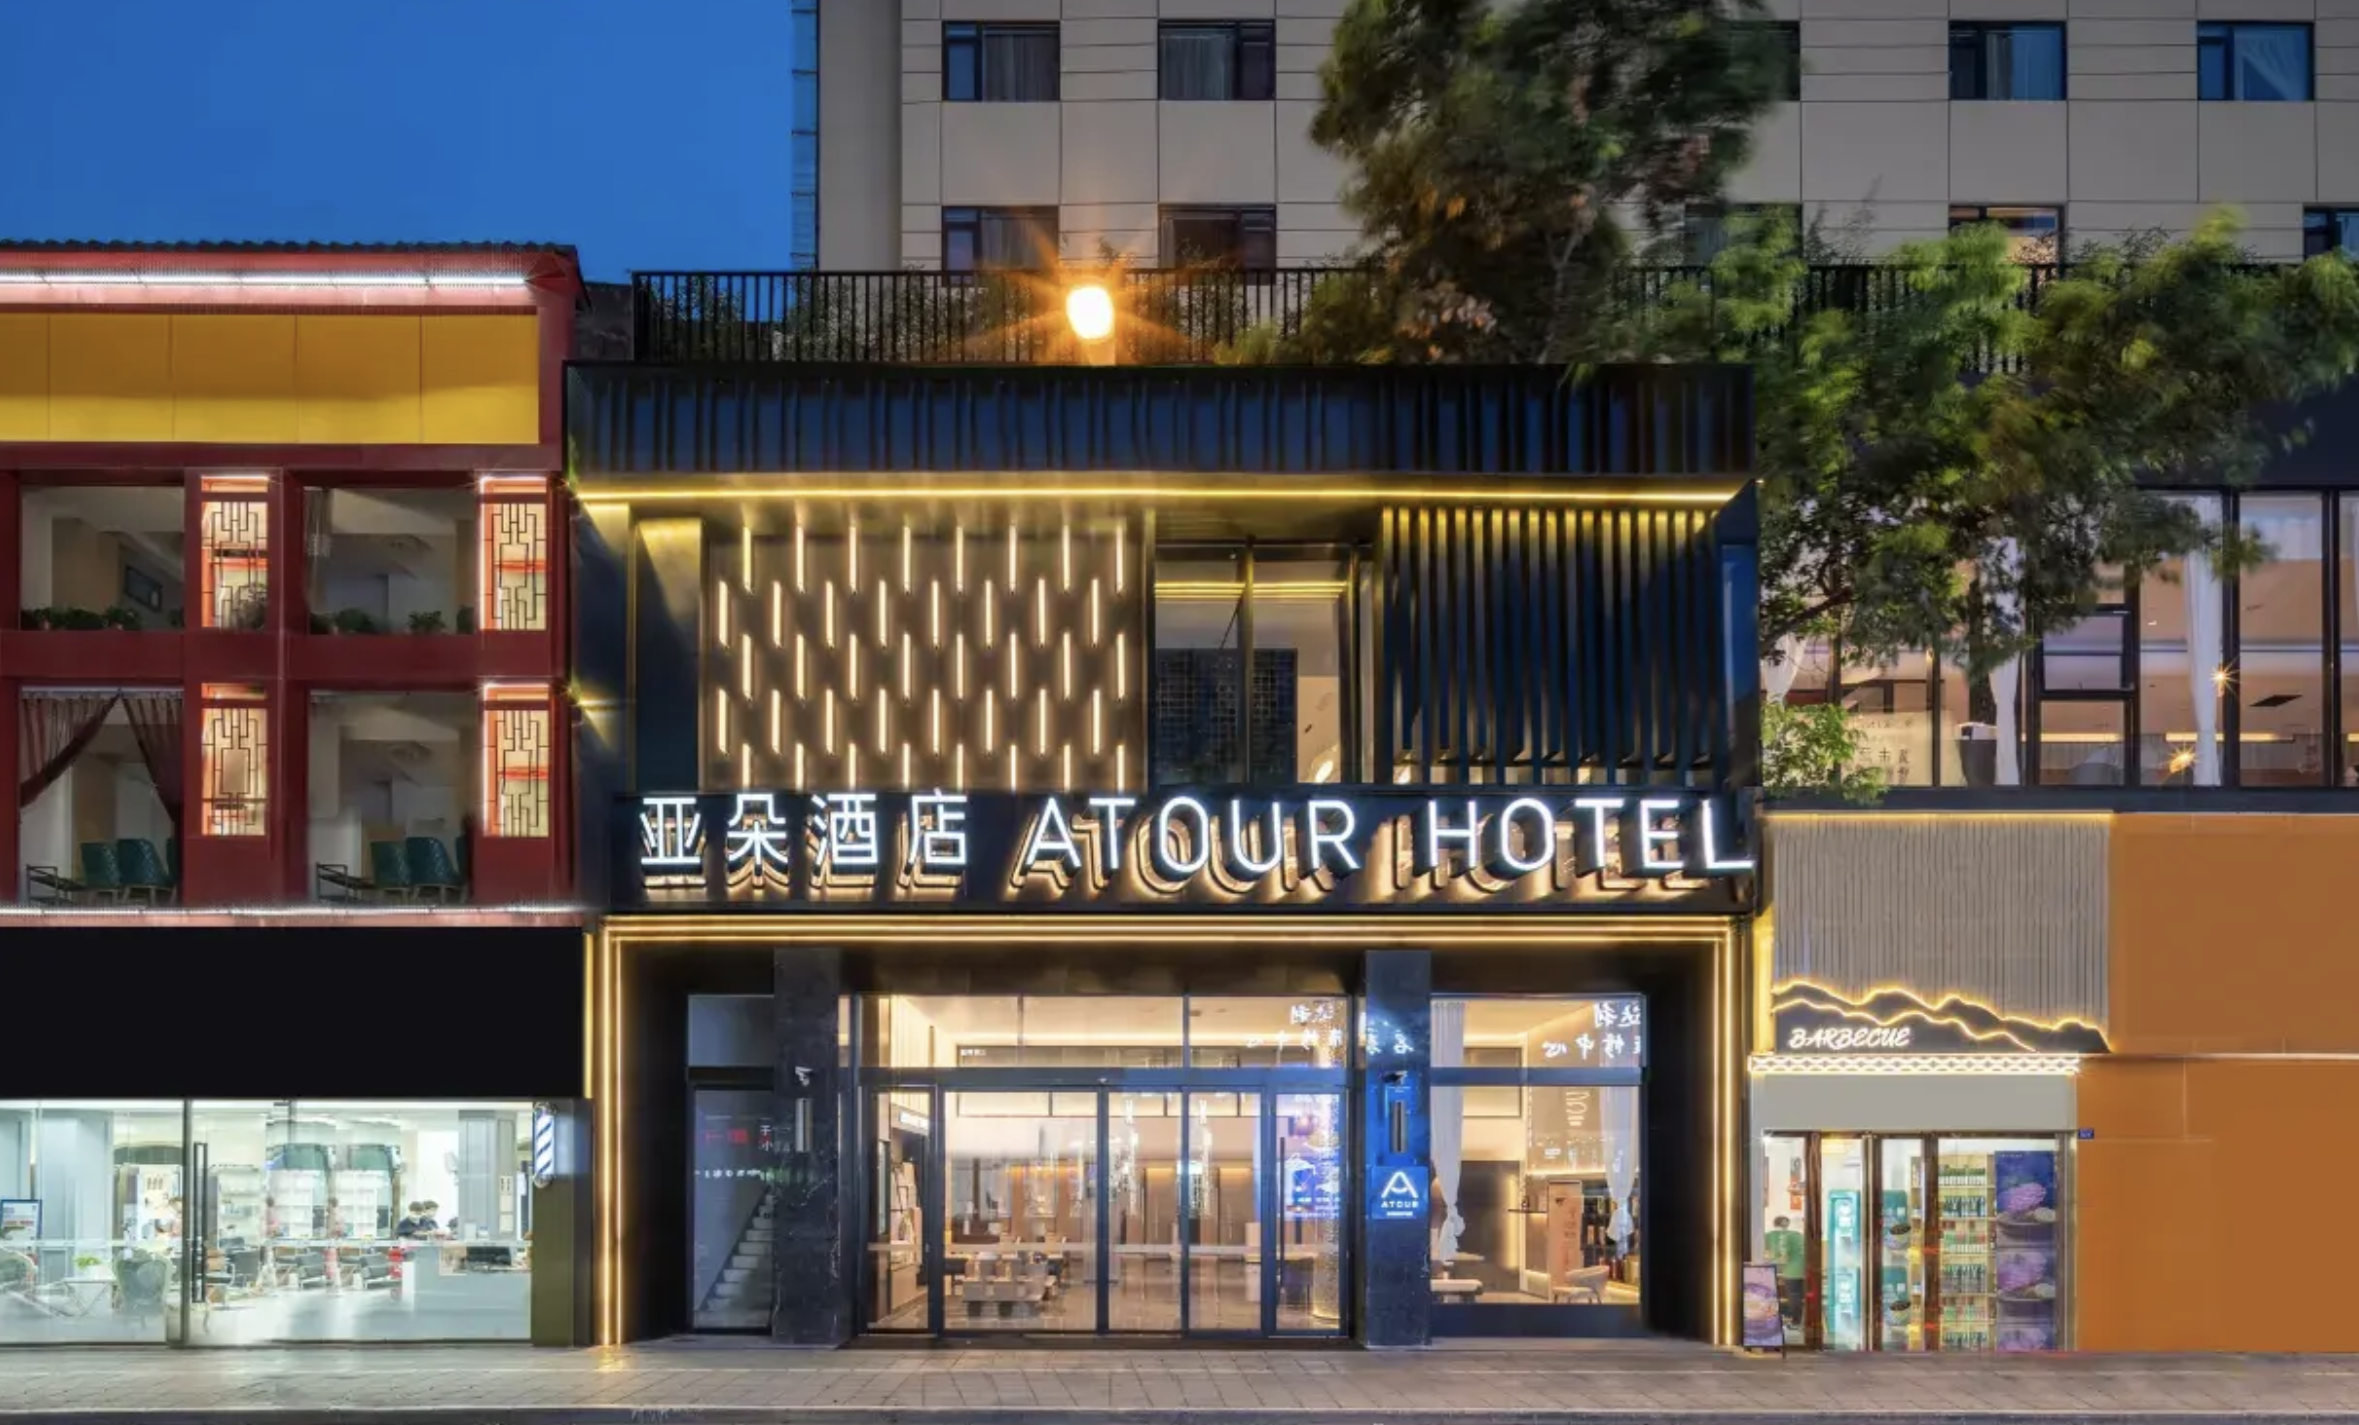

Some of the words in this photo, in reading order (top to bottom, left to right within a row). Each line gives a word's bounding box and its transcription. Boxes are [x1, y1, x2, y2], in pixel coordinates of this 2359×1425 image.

[640, 788, 968, 866] 亚朵酒店
[1025, 796, 1361, 872] ATOUR
[1428, 797, 1756, 869] HOTEL
[1788, 1026, 1912, 1050] BARBECUE
